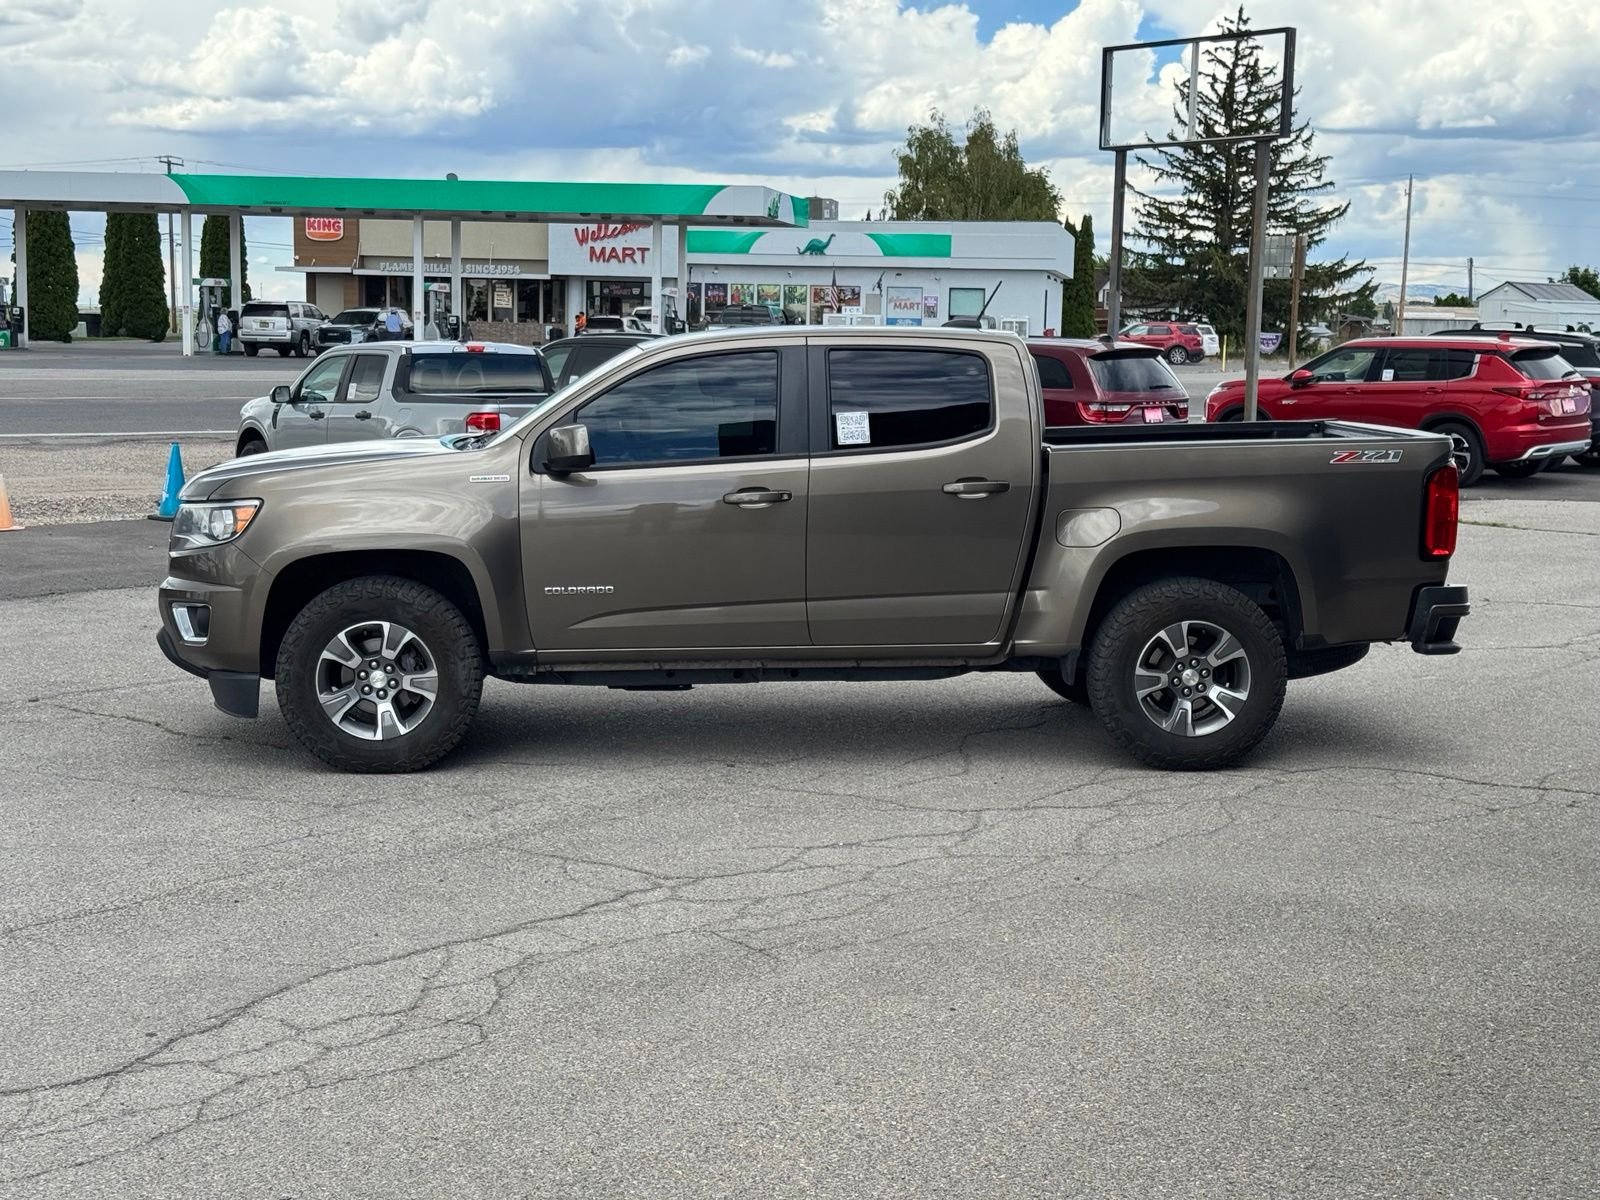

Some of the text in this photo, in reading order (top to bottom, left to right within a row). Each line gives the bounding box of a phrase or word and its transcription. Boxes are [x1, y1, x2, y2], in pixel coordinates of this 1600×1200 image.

[307, 219, 341, 232] KING
[589, 246, 650, 264] MART
[380, 262, 414, 272] FLAME
[465, 264, 495, 274] SINCE
[496, 265, 520, 274] 1954
[893, 302, 921, 310] MART
[1329, 449, 1403, 464] Z71
[544, 586, 614, 595] COLORADO
